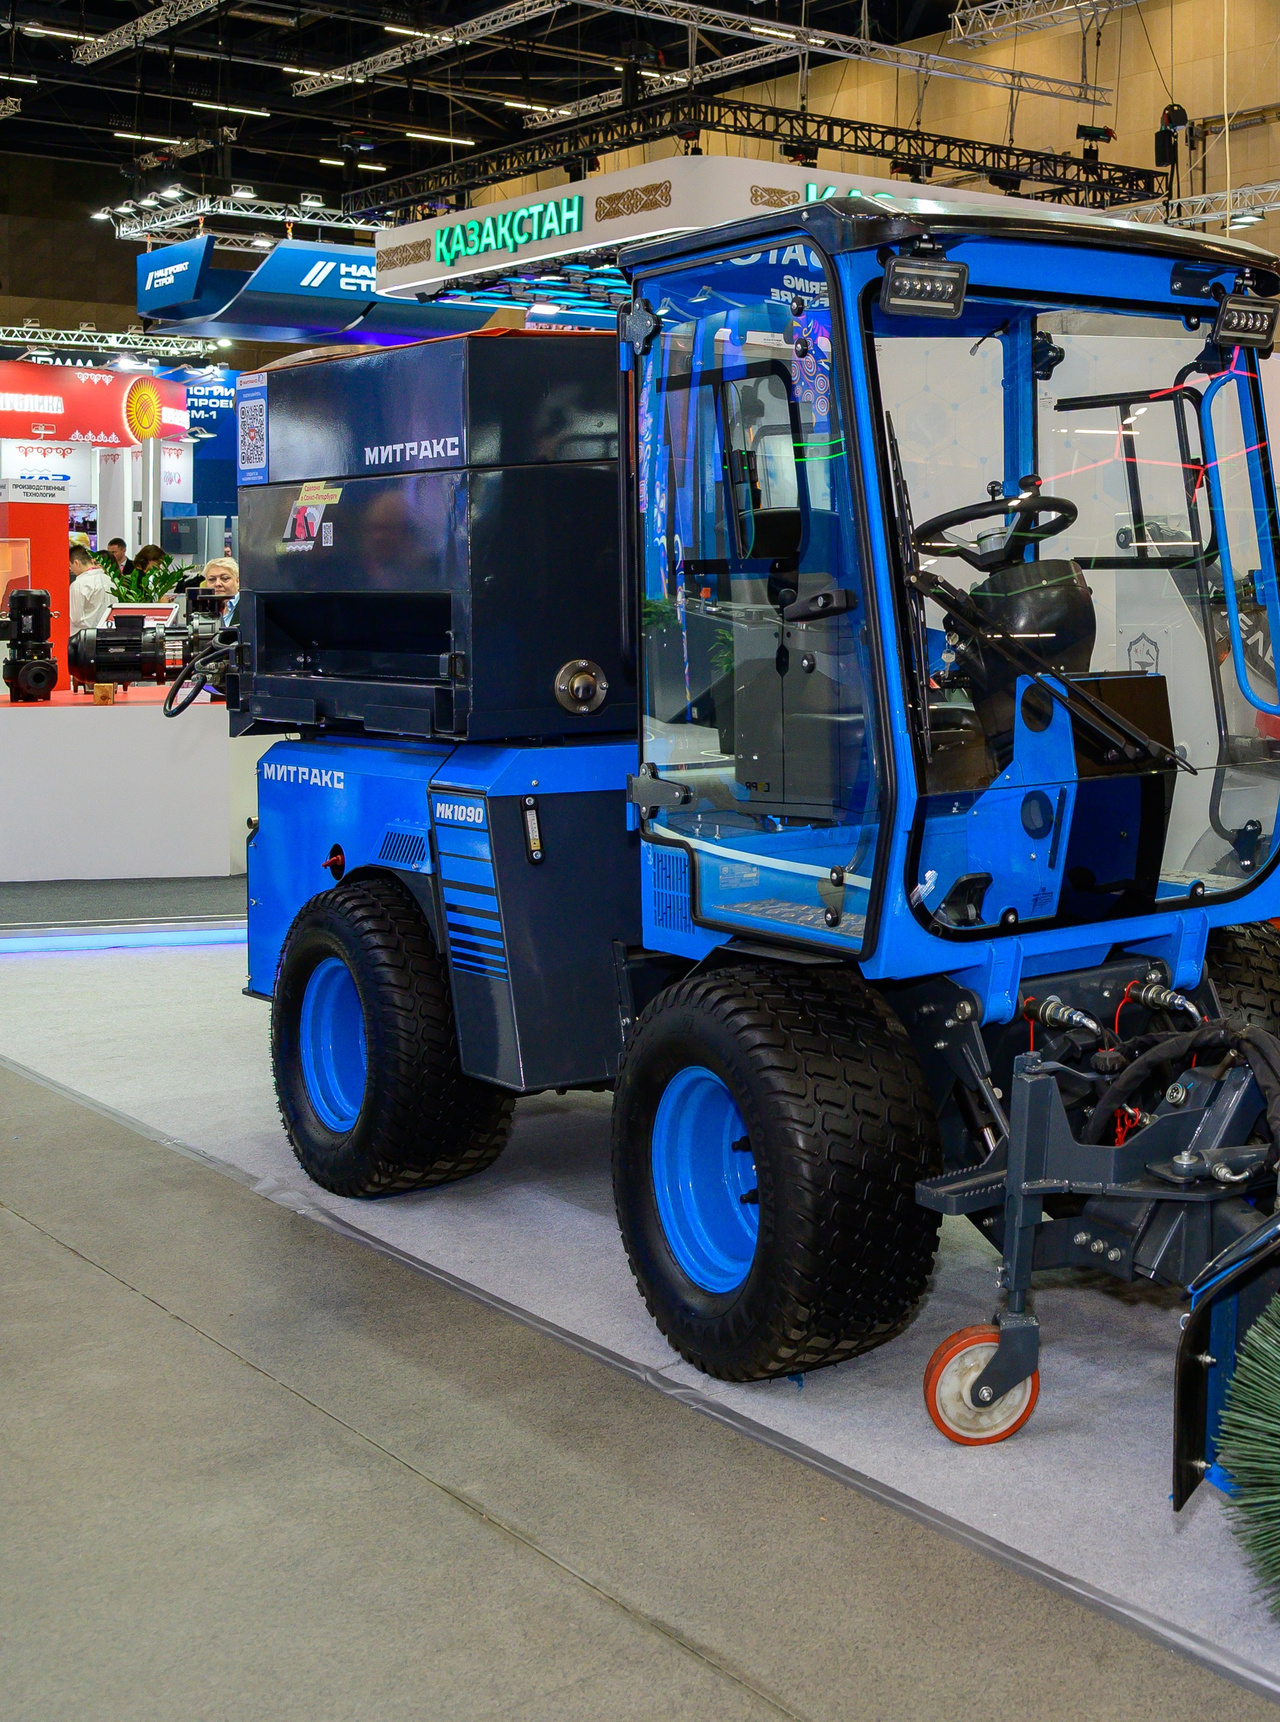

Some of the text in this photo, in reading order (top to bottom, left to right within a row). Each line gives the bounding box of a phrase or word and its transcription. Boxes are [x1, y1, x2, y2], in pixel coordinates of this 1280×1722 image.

[435, 195, 583, 266] ҚАЗАҚСТАН
[364, 436, 459, 465] МИТРАКС
[263, 762, 344, 789] МИТРАКС
